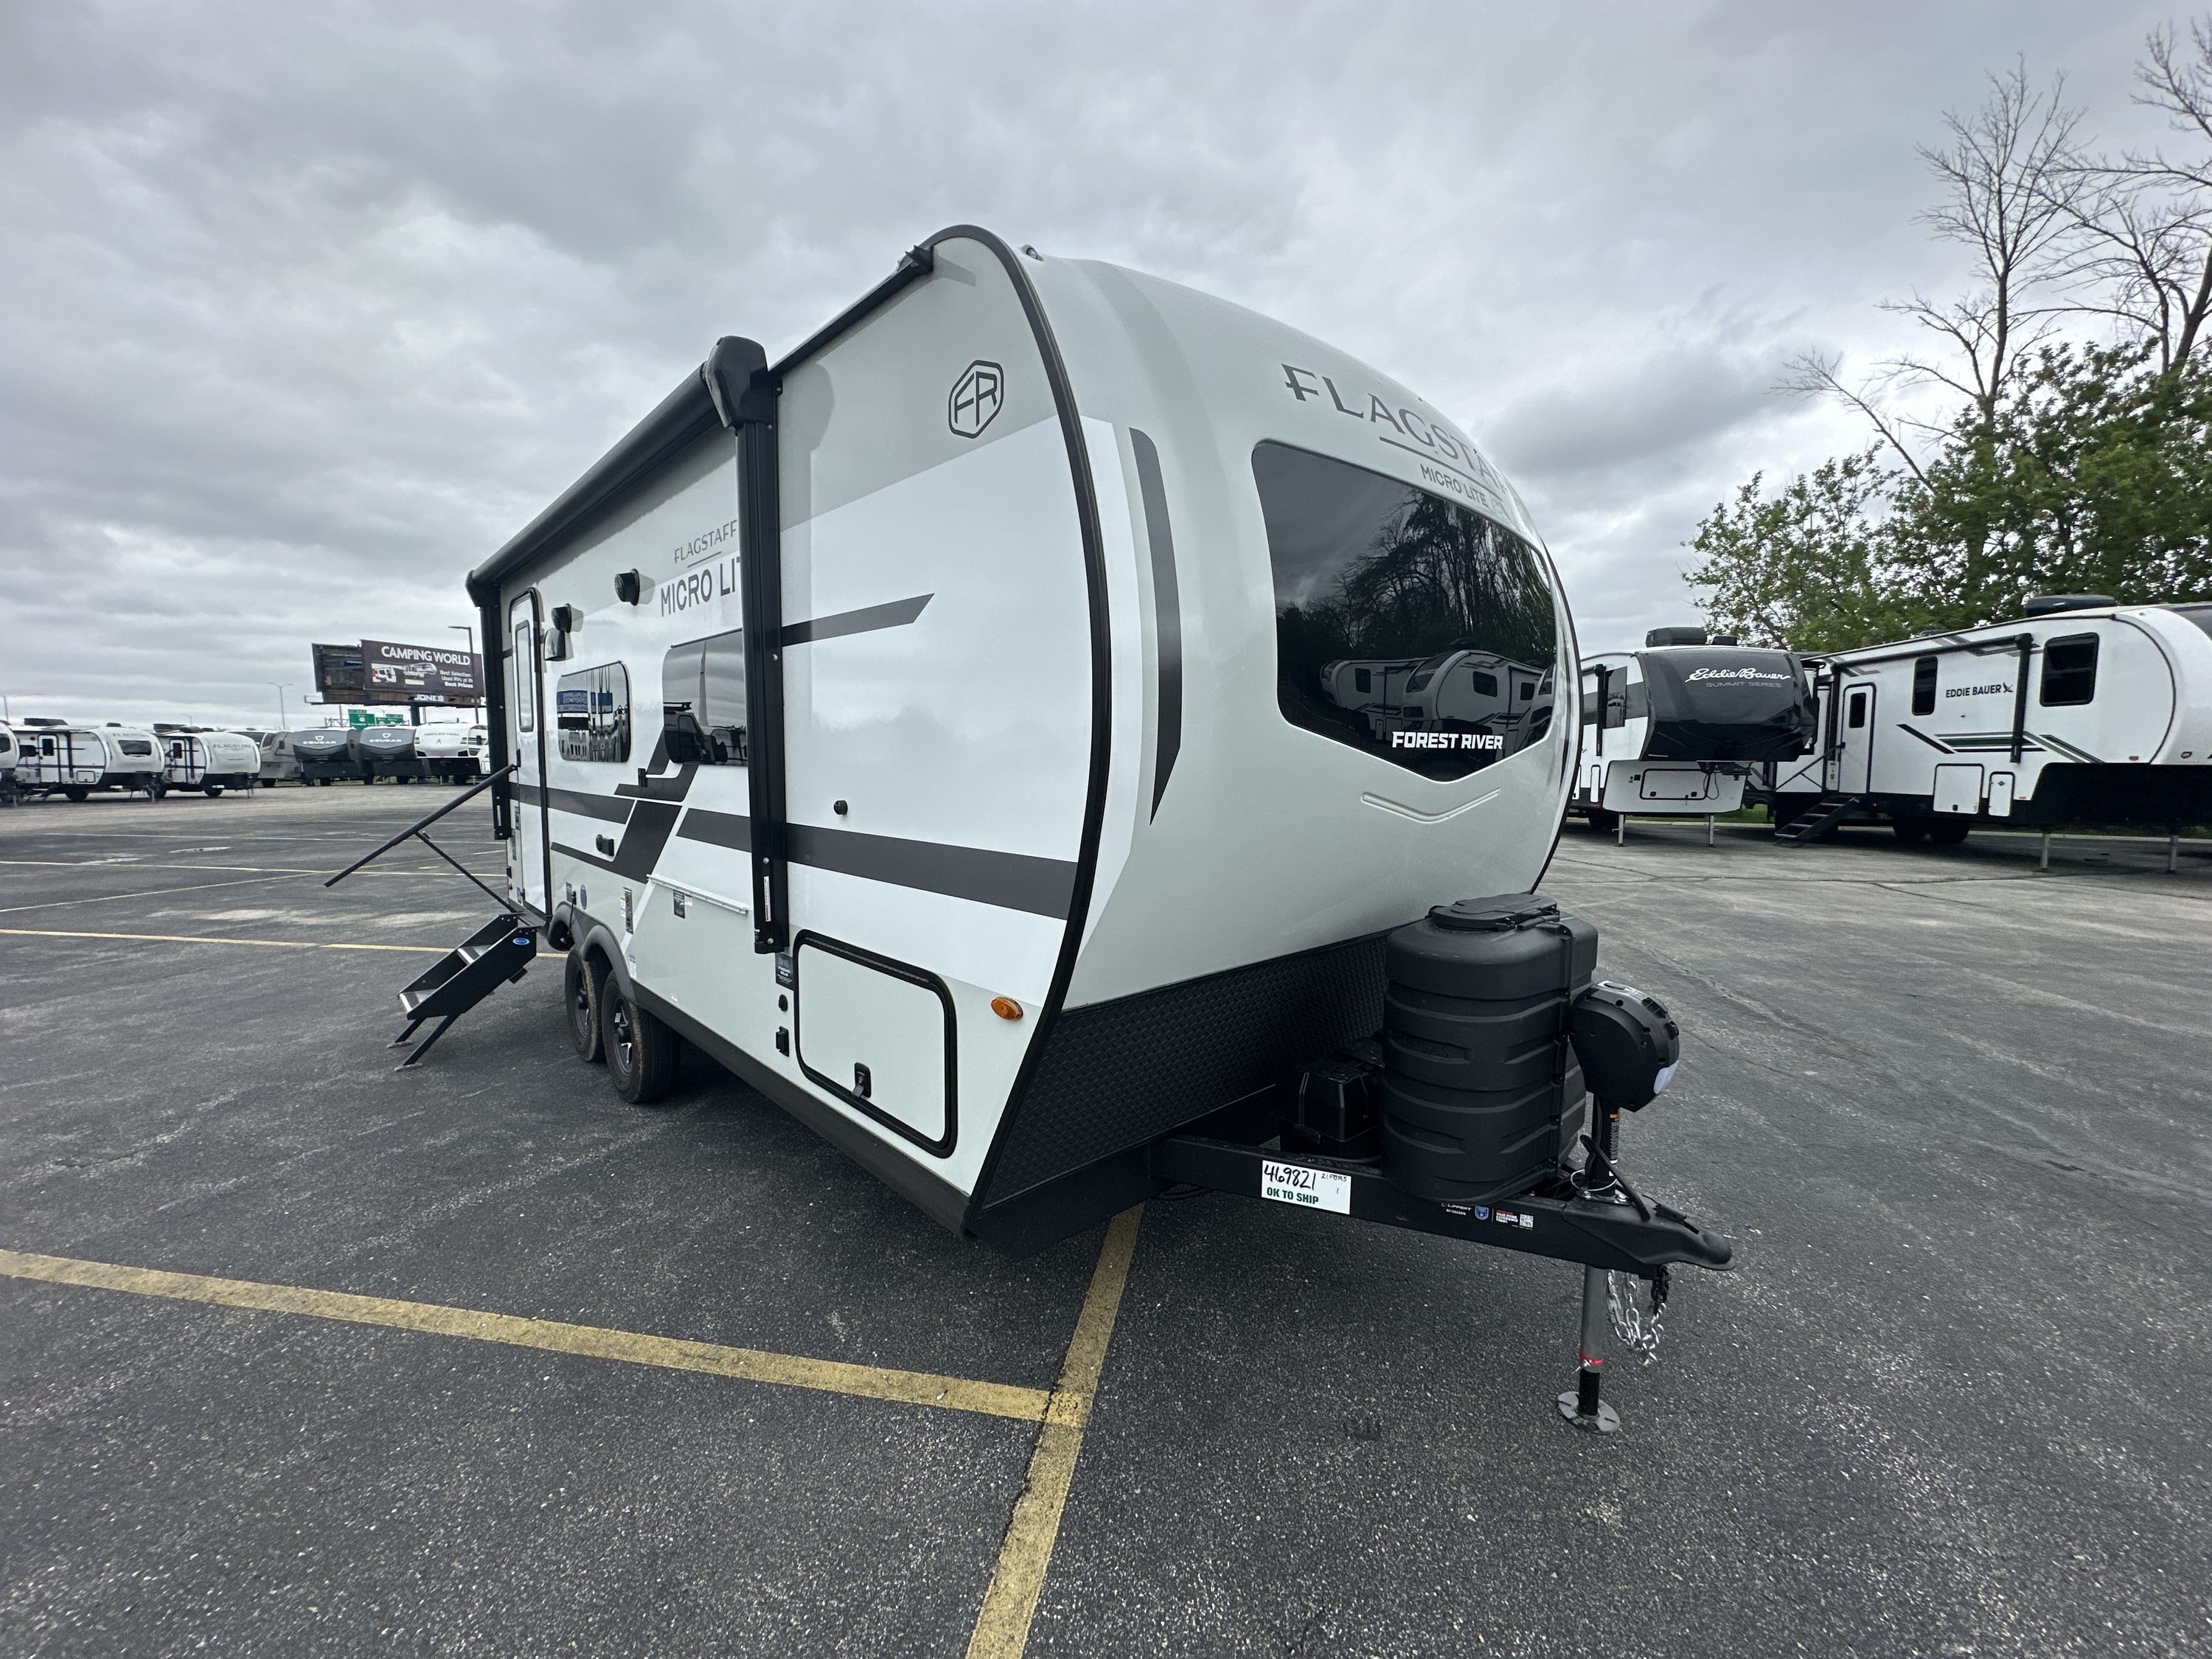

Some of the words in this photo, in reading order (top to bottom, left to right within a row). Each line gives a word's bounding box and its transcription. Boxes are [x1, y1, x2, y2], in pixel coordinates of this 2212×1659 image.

[1420, 463, 1462, 494] MICRO
[1464, 483, 1489, 508] LITE
[674, 519, 737, 564] FLAGSTAFF
[661, 568, 713, 617] MICRO
[381, 646, 432, 661] CAMPING
[433, 652, 470, 666] WORLD
[414, 694, 444, 702] JONES
[1946, 687, 1971, 698] EDDIE
[1972, 684, 2002, 695] BAUER
[1391, 731, 1459, 749] FOREST
[1461, 734, 1504, 750] RIVER
[1264, 1164, 1317, 1191] 469821
[1267, 1186, 1280, 1197] OK
[1281, 1189, 1294, 1200] TO
[1296, 1192, 1319, 1205] SHIP
